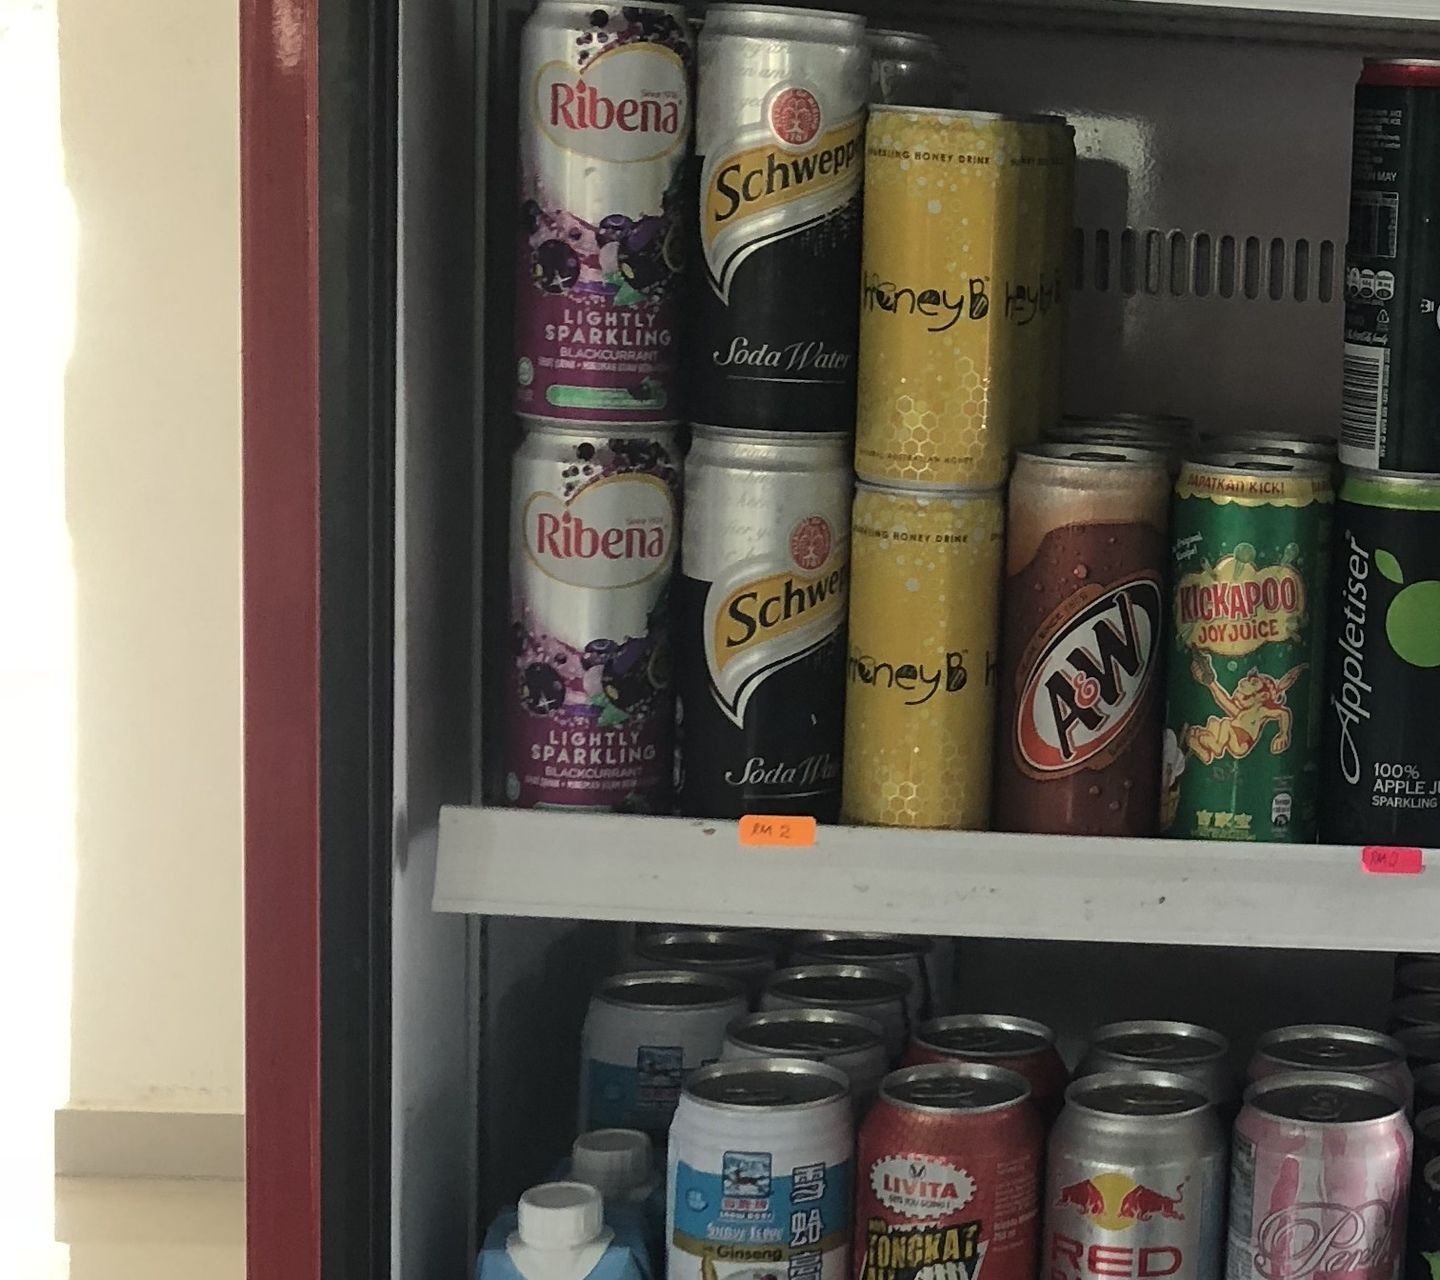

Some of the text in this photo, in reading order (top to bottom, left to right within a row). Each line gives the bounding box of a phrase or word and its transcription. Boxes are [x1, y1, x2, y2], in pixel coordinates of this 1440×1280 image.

[550, 78, 681, 135] Ribena
[564, 309, 656, 327] LIGHTLY
[545, 324, 672, 346] SPARKLING
[560, 346, 659, 361] BLACKCURRANT
[713, 336, 851, 368] Soda Water
[537, 510, 664, 560] Ribena
[1180, 577, 1297, 624] KICKAPOO
[1199, 622, 1226, 644] JOY
[1339, 531, 1372, 785] Appletiser
[1045, 591, 1144, 761] A&W
[549, 729, 639, 746] LIGHTLY
[531, 744, 656, 763] SPARKLING
[725, 757, 795, 786] Soda
[1373, 762, 1420, 780] 100%
[1373, 778, 1426, 794] APPLE
[1372, 795, 1438, 810] SPARKLING
[779, 823, 791, 839] 2
[882, 1173, 960, 1200] LIVITA
[717, 1245, 783, 1263] Ginseng
[1051, 1232, 1183, 1277] RED
